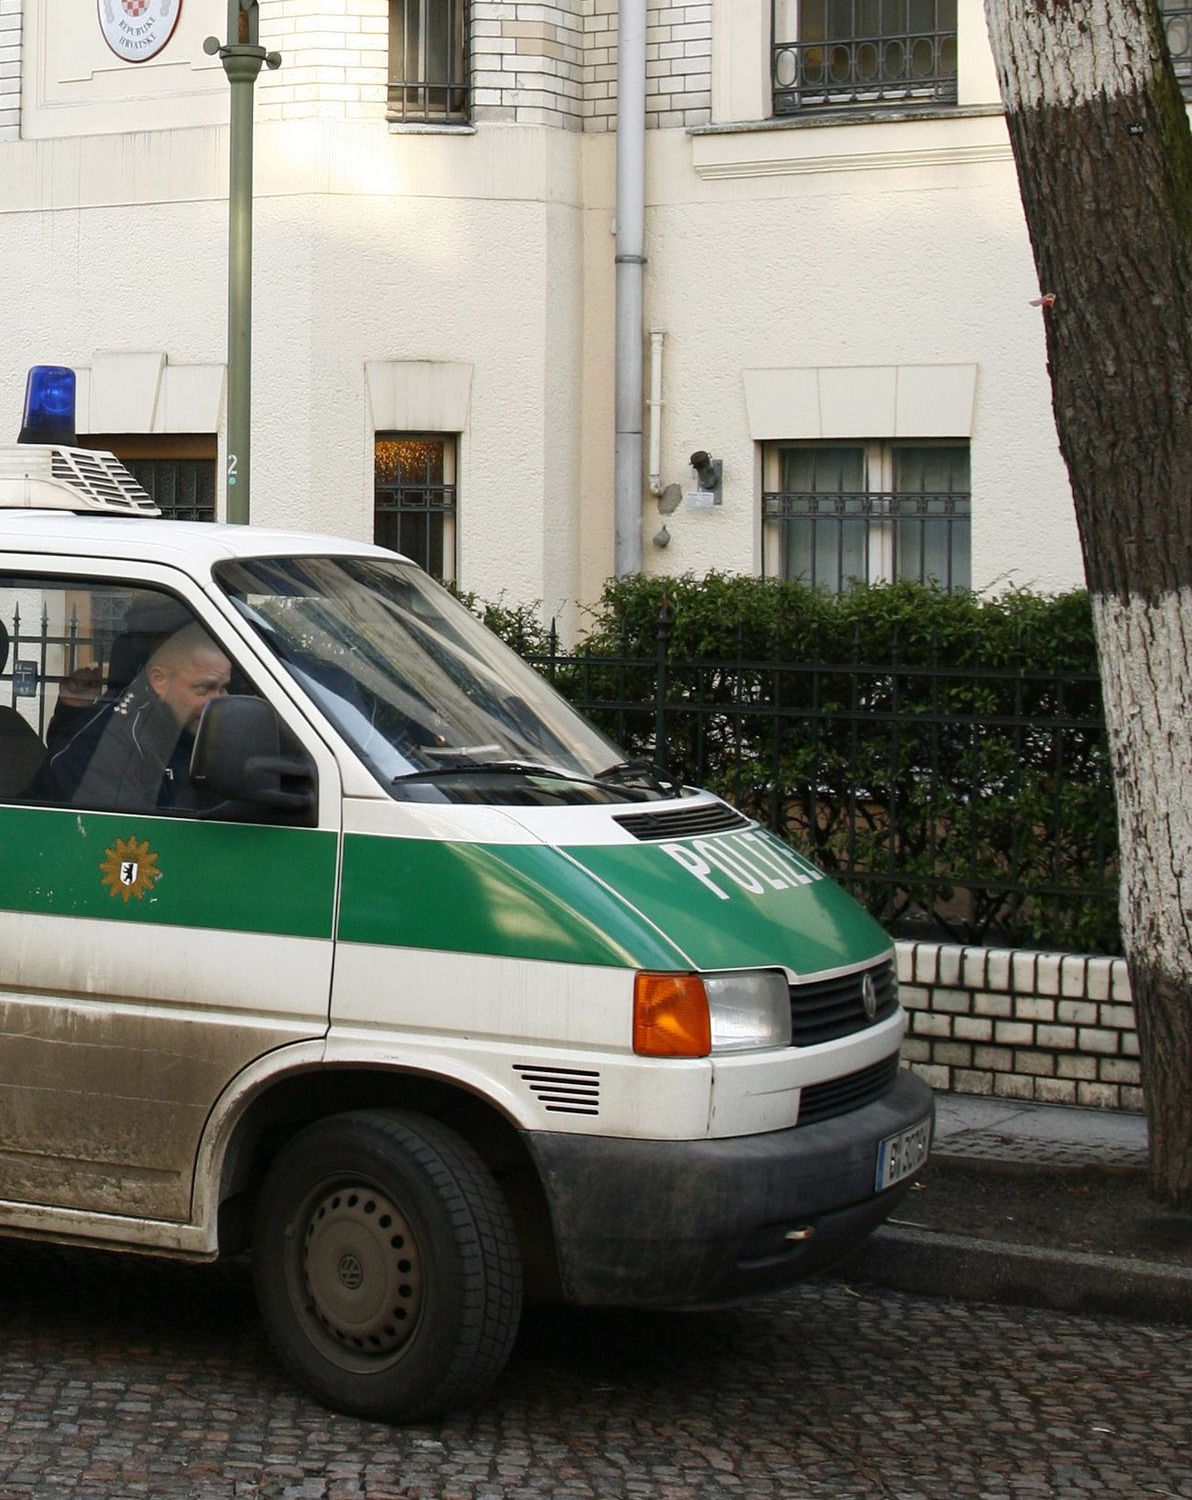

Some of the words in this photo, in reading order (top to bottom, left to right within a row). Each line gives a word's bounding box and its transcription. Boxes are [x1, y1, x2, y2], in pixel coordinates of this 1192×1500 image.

[118, 16, 157, 36] REPUBLIKE
[119, 32, 157, 49] HRVATSKE
[228, 454, 238, 475] 2
